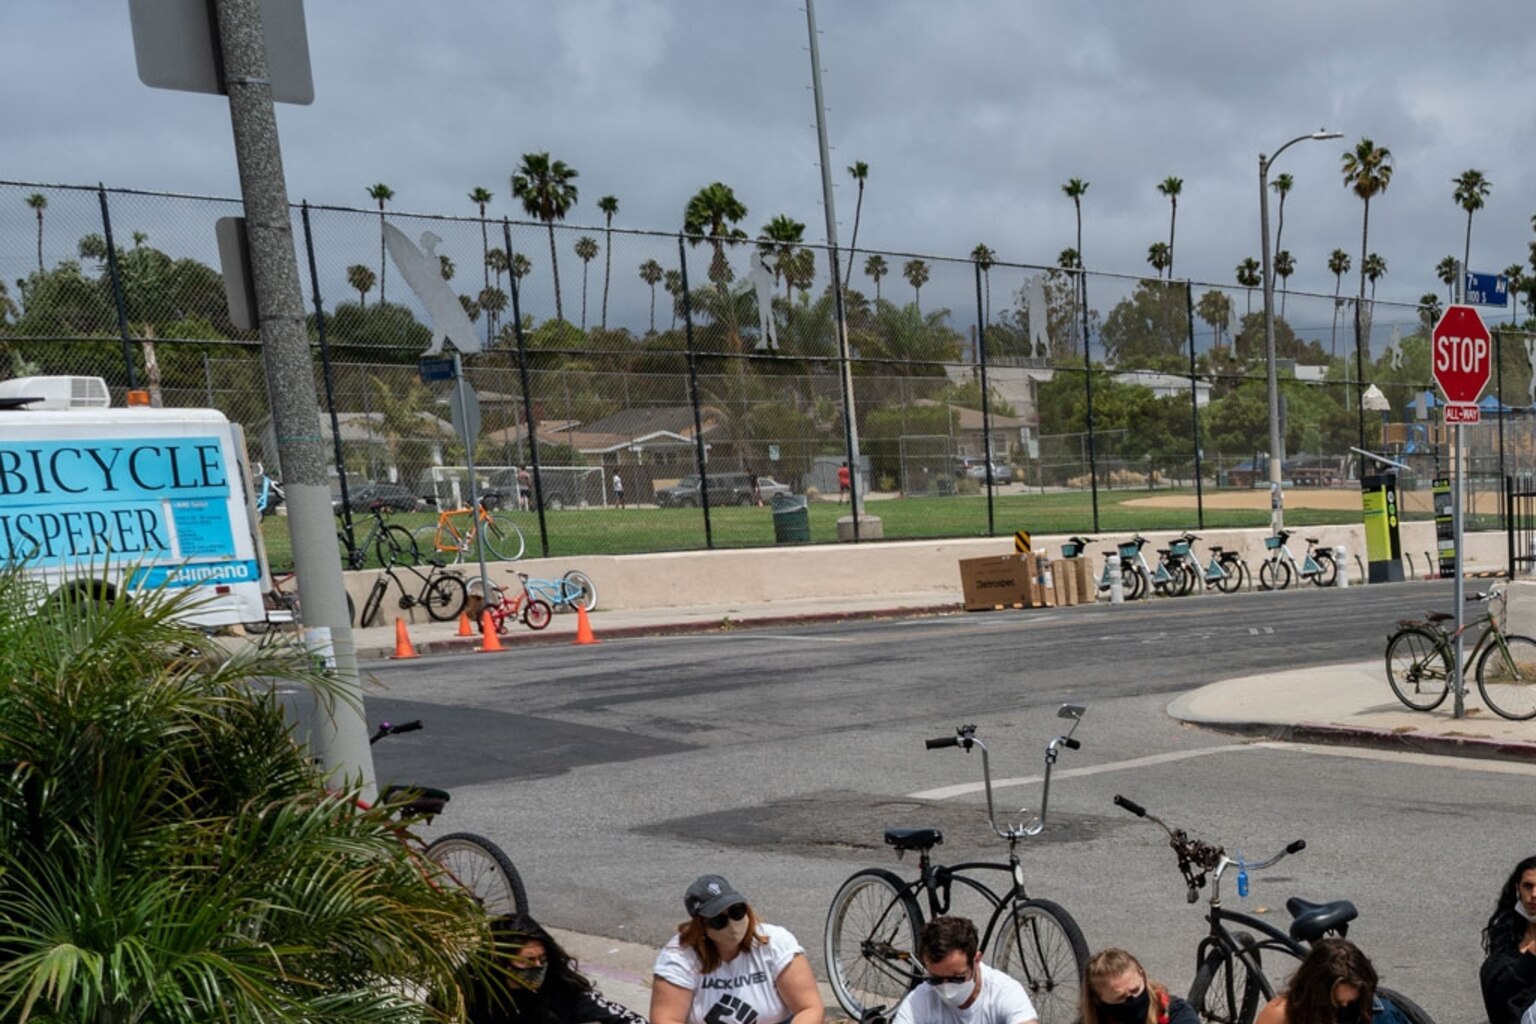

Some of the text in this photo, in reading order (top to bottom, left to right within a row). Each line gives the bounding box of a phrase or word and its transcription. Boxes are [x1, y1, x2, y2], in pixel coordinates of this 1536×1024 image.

[1437, 335, 1487, 373] STOP
[1445, 408, 1478, 422] ALL-WAY
[0, 445, 226, 496] BICYCLE
[0, 508, 171, 561] ISPERER
[166, 564, 249, 583] SHIMANO
[701, 971, 768, 990] LACK LIVES
